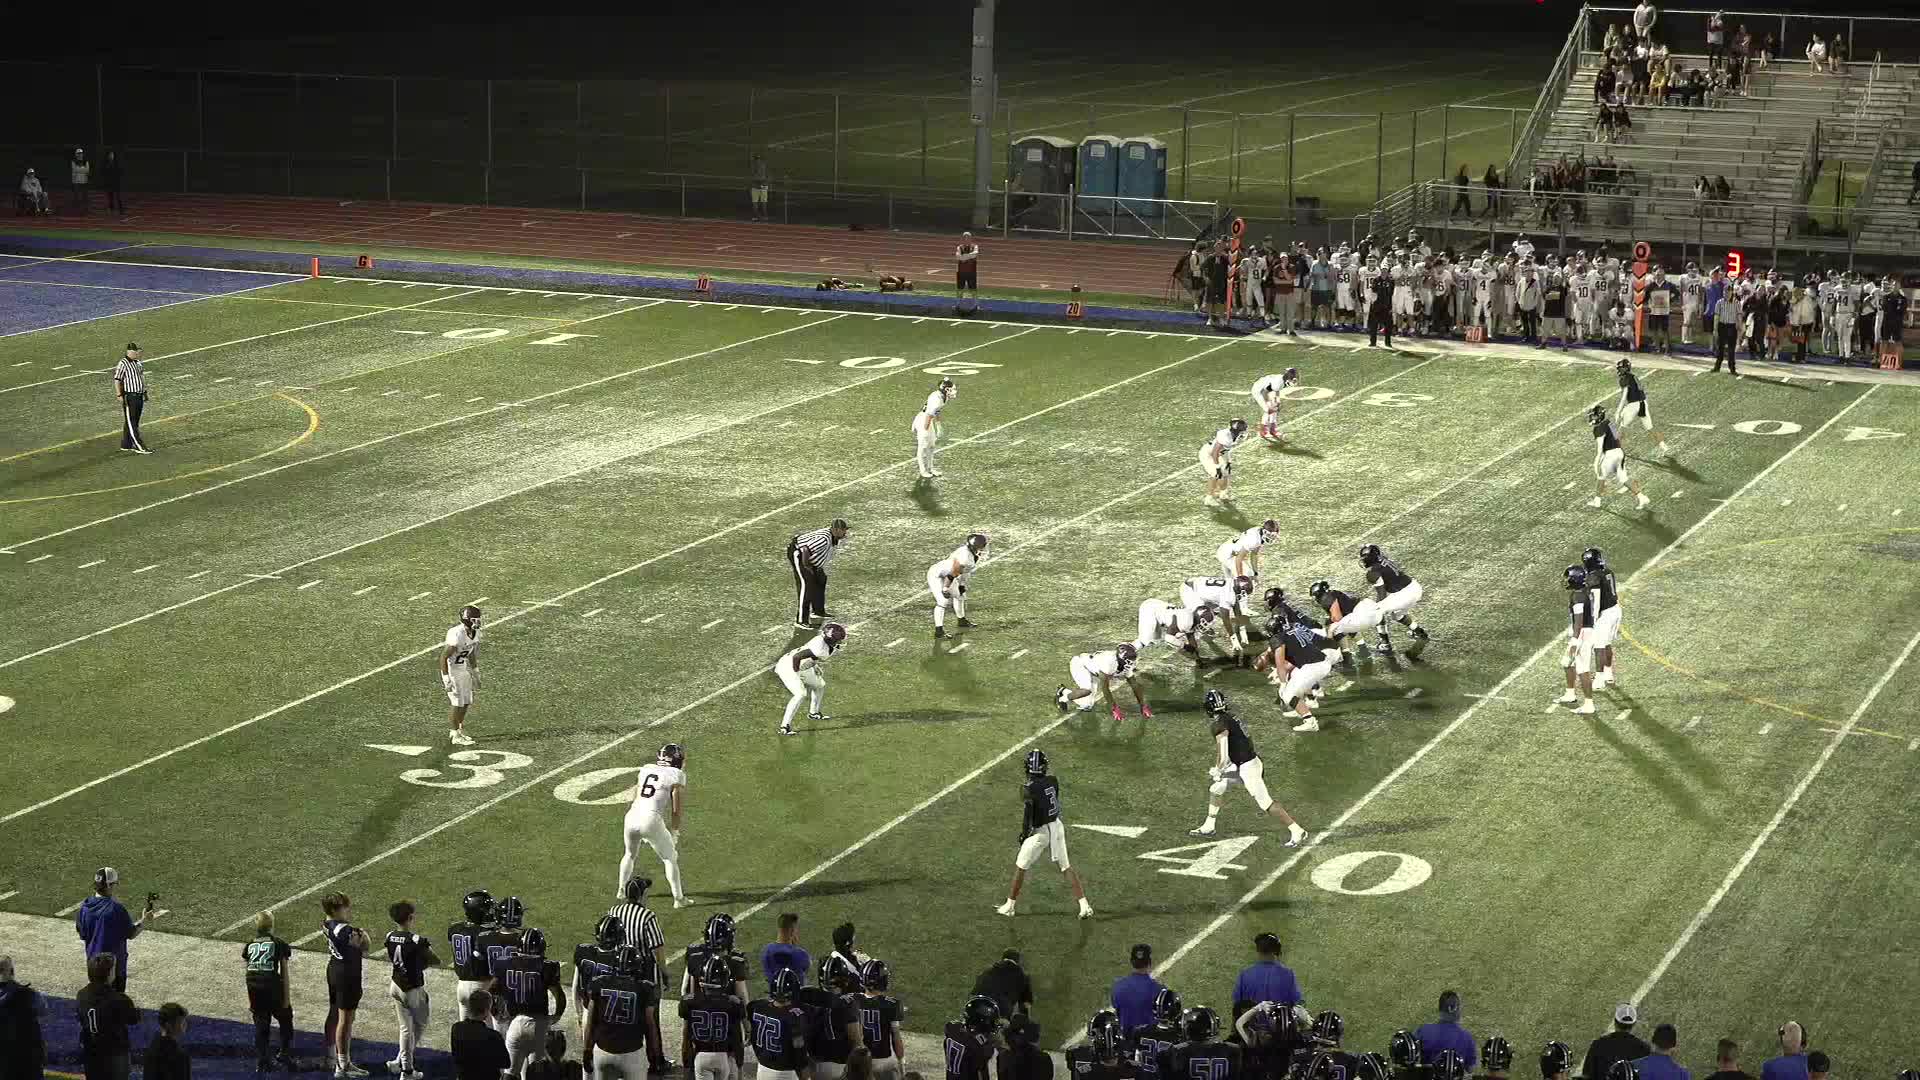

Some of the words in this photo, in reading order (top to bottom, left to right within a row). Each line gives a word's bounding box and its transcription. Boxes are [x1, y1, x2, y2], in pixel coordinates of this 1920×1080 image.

[358, 256, 367, 267] G
[1728, 252, 1740, 278] 3
[696, 278, 708, 290] 10
[1067, 302, 1080, 315] 20
[641, 773, 659, 798] 6
[1044, 785, 1058, 816] 3
[247, 941, 275, 971] 22
[452, 933, 471, 966] 81
[506, 969, 541, 1004] 40
[87, 1008, 98, 1034] 1
[601, 988, 637, 1025] 73
[691, 1009, 729, 1042] 28
[752, 1012, 783, 1053] 72
[946, 1037, 966, 1075] 17
